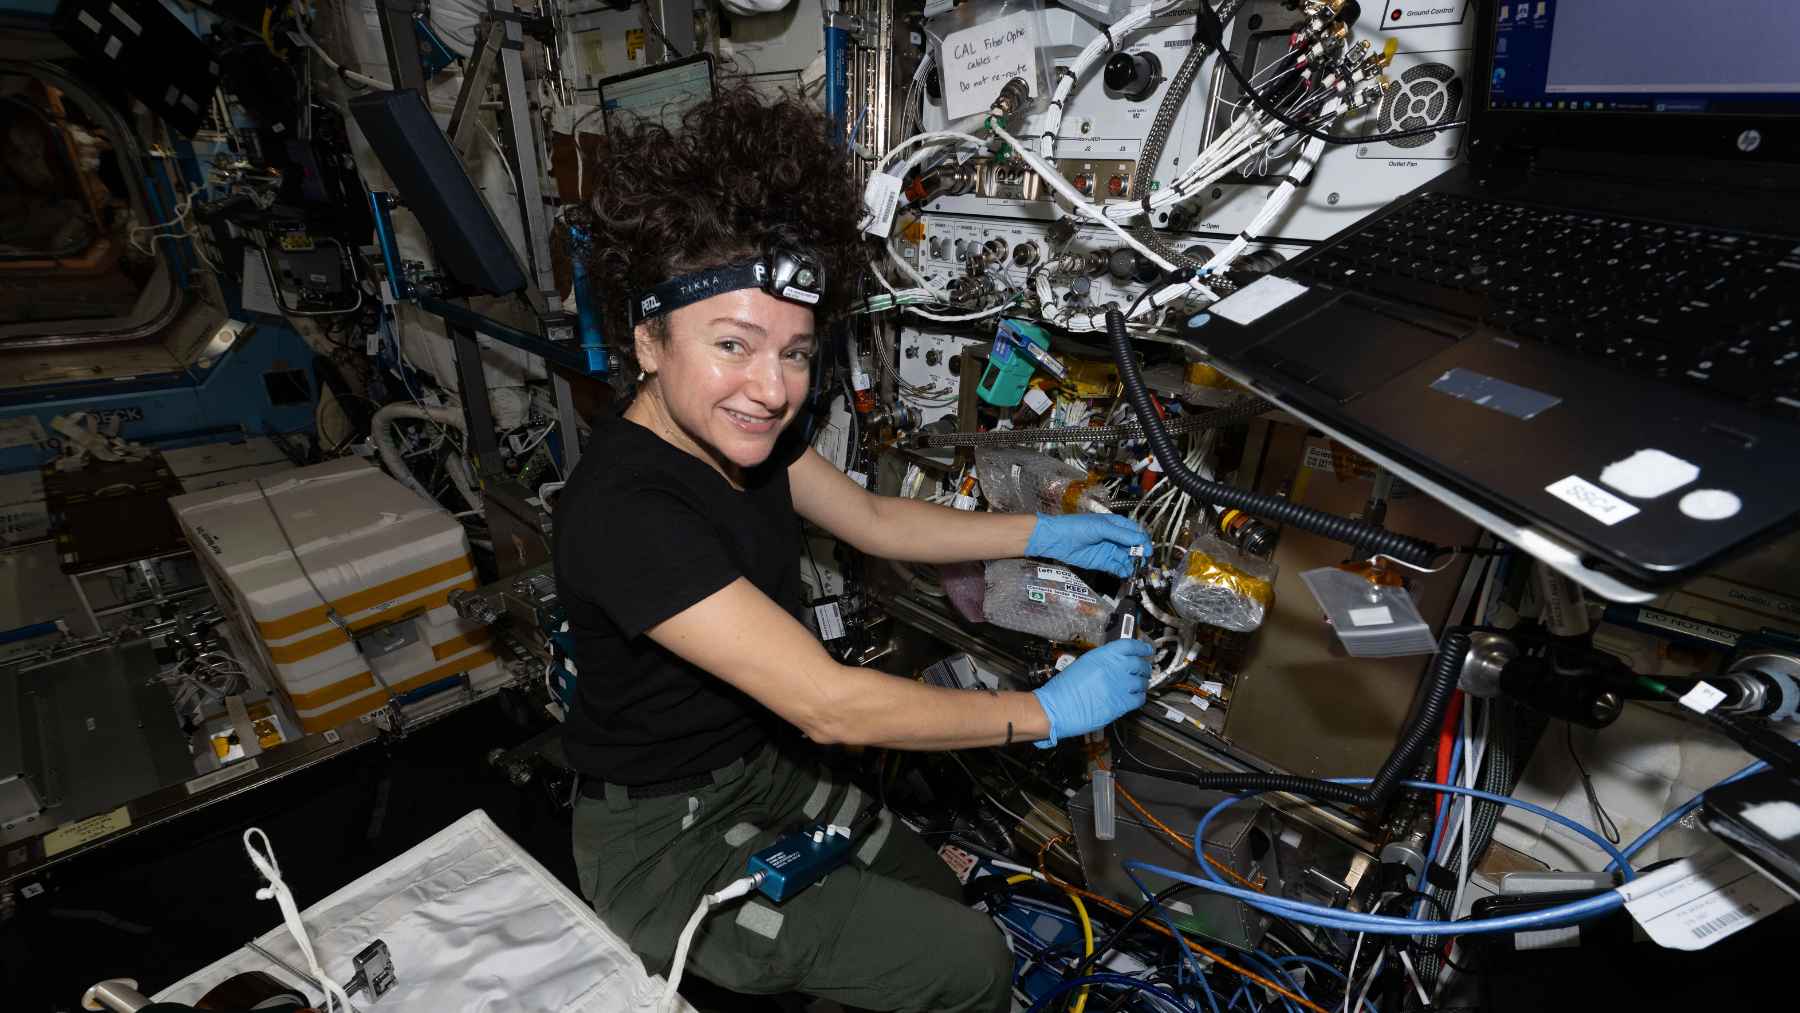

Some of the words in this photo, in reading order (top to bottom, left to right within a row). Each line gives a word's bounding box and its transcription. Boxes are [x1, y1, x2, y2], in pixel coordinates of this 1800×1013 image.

[954, 42, 977, 60] CAL
[983, 35, 1005, 50] Fiber
[967, 55, 991, 70] cables
[959, 81, 970, 93] Do
[973, 75, 989, 87] not
[992, 64, 1027, 81] re-route
[1737, 129, 1760, 152] hp
[1206, 222, 1220, 231] Open
[680, 276, 720, 295] TIKKA
[641, 295, 662, 316] PETZL
[1565, 485, 1617, 513] SSC4
[1066, 584, 1088, 593] KEEP
[1646, 612, 1666, 622] DO
[1671, 618, 1700, 630] NOT
[1706, 627, 1741, 640] MOV
